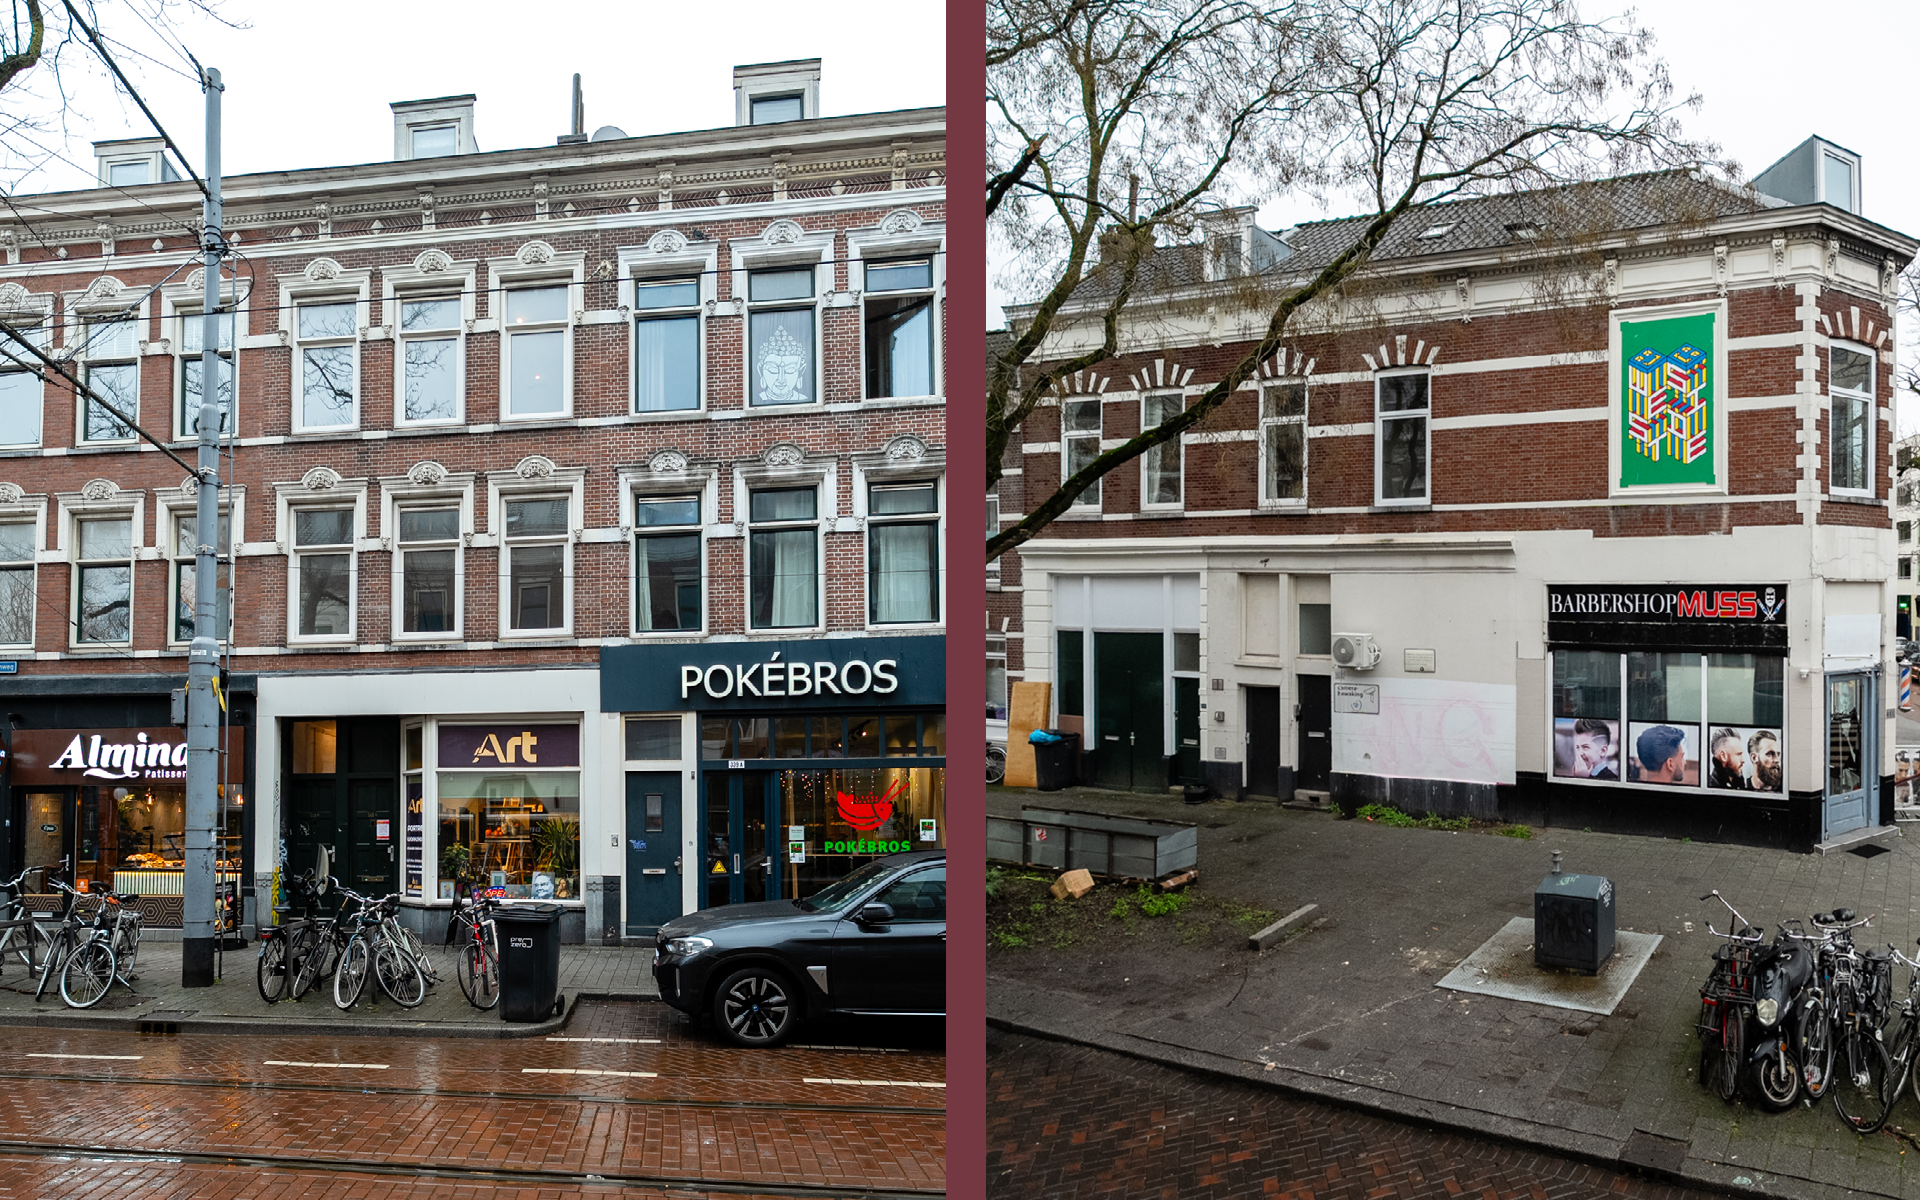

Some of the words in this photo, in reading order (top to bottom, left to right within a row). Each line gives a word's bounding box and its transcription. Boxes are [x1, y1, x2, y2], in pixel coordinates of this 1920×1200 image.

[1550, 593, 1677, 613] BARBERSHOP
[1677, 590, 1757, 618] MUSS
[681, 651, 898, 699] POKÉBROS
[49, 732, 188, 779] Almina
[472, 731, 538, 763] Art
[824, 838, 911, 853] POKÉBROS
